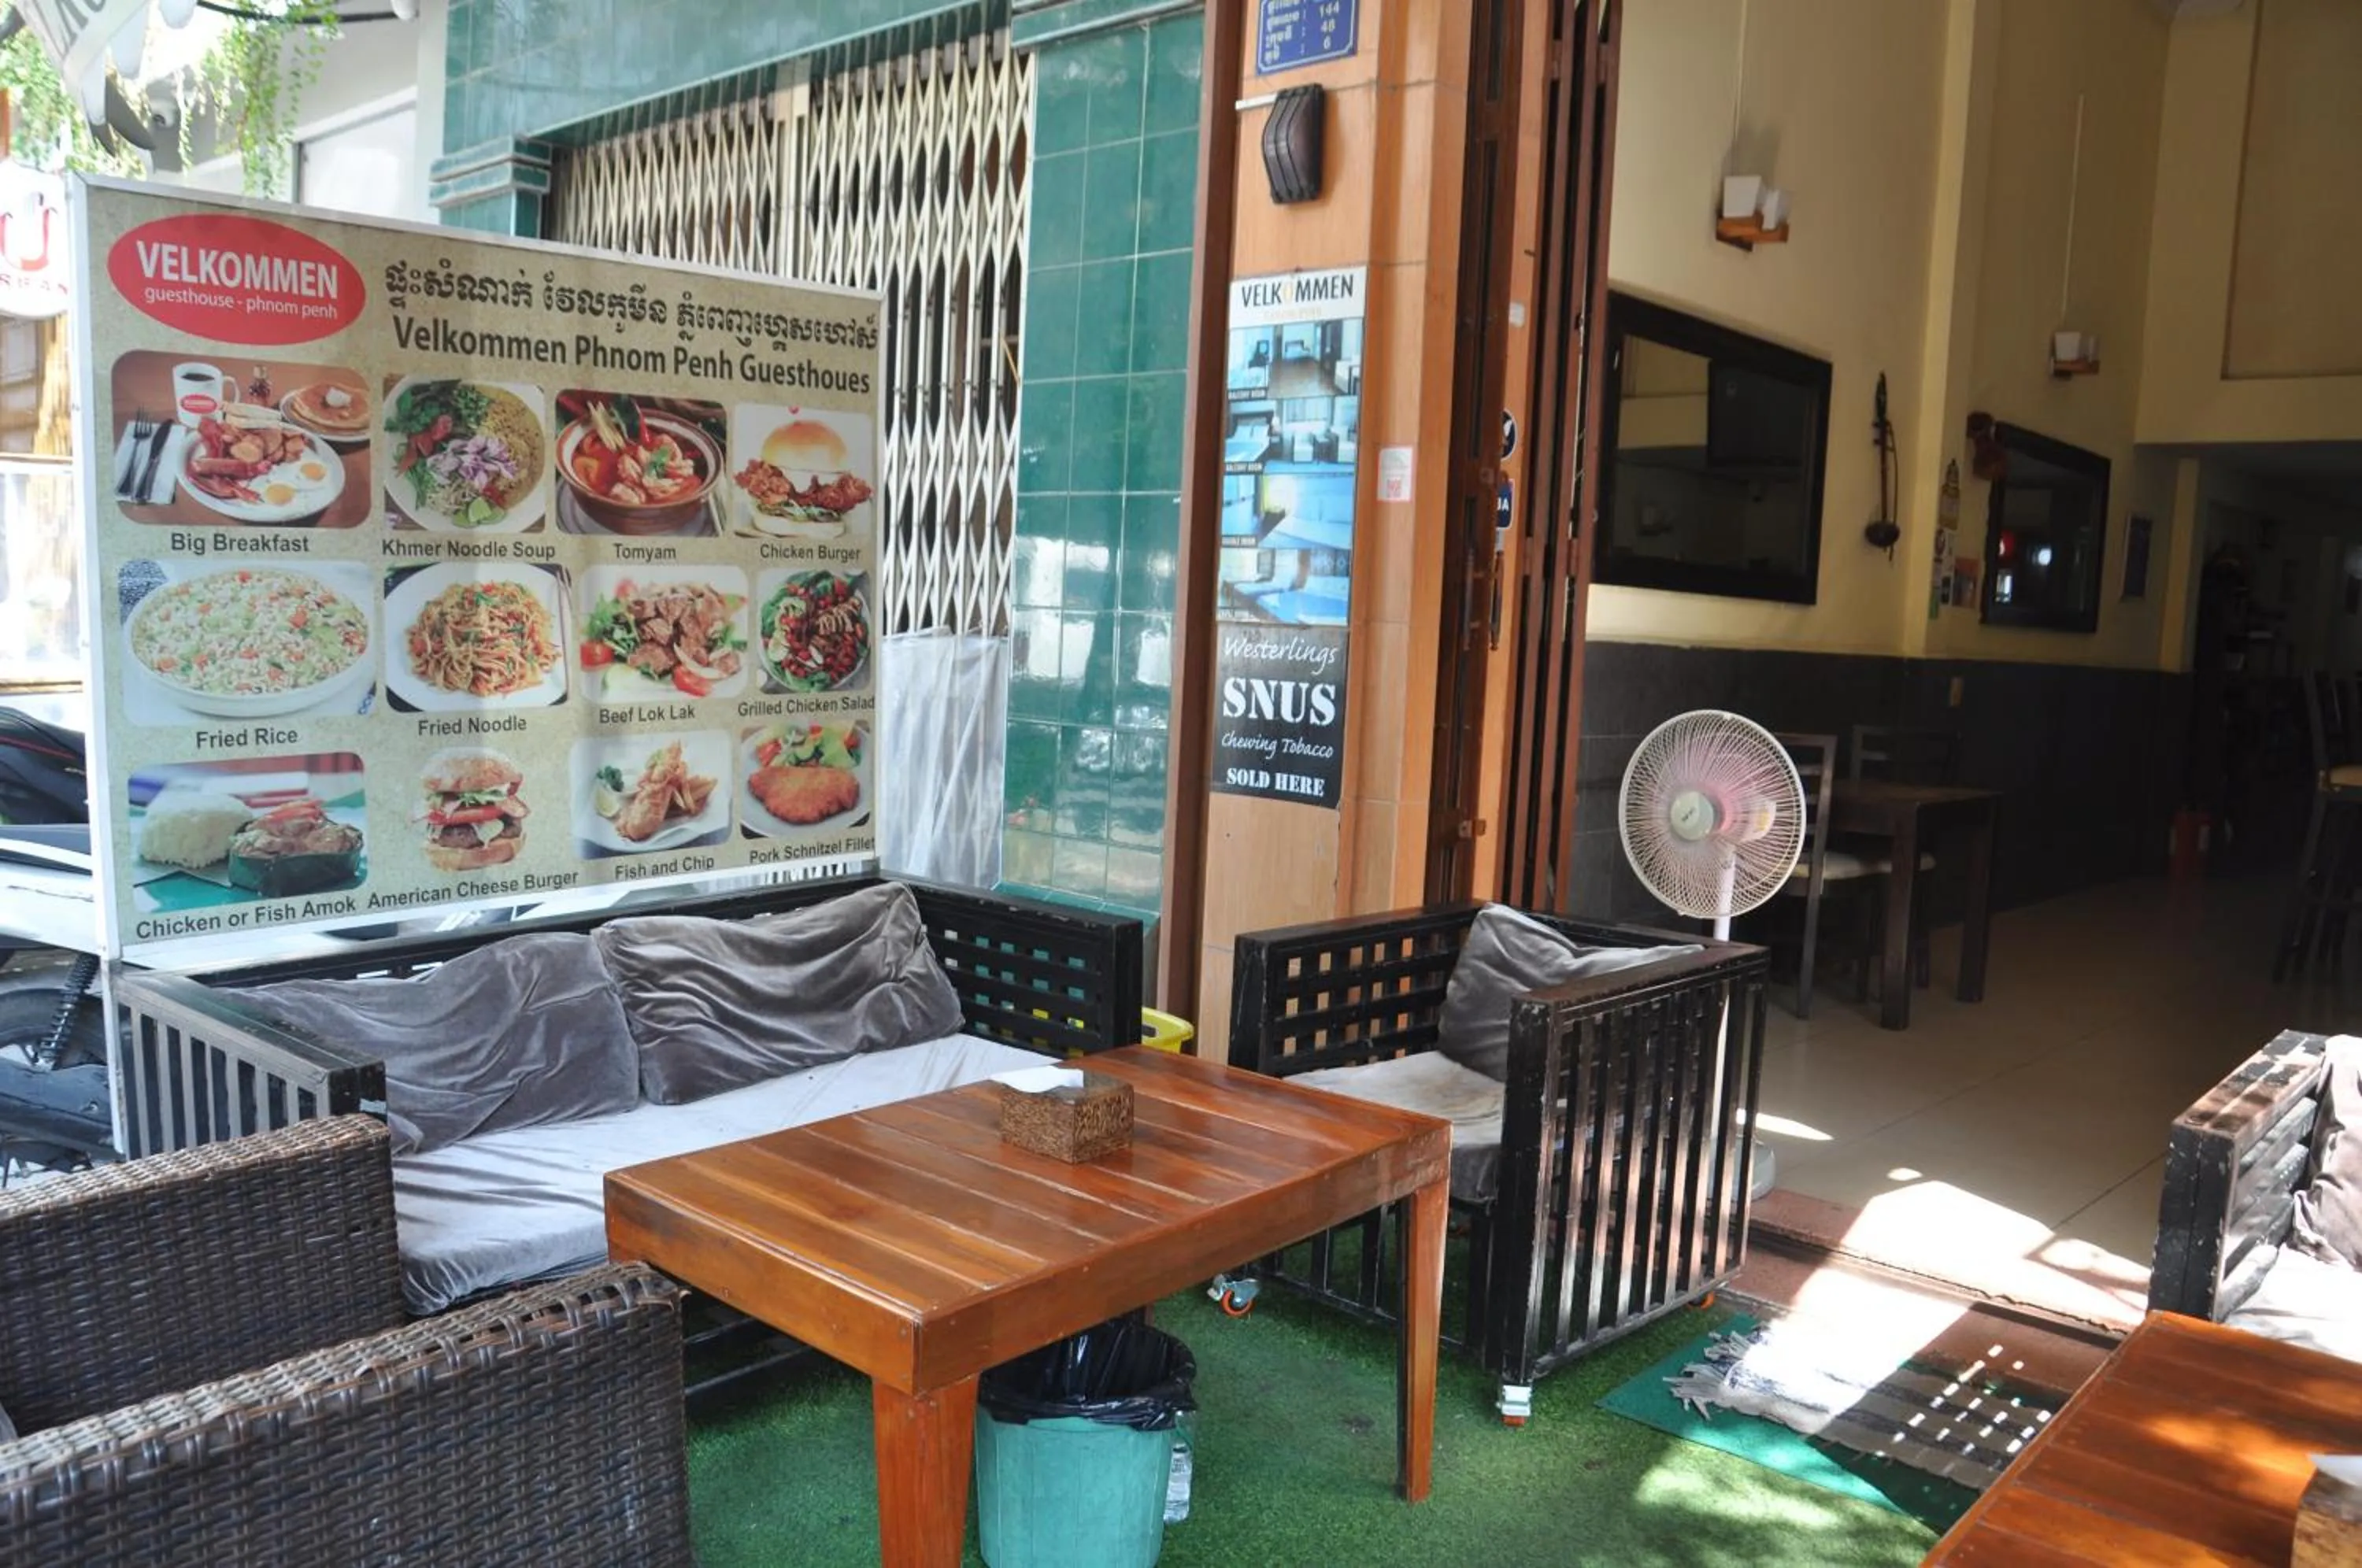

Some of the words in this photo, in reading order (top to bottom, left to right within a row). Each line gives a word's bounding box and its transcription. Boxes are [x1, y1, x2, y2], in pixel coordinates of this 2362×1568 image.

[136, 240, 338, 299] VELKOMMEN
[145, 287, 234, 308] guesthouse
[246, 296, 298, 314] phnom
[302, 304, 338, 319] penh
[393, 315, 566, 364] Velkommen
[576, 335, 665, 374] Phnom
[674, 346, 733, 380] Penh
[740, 354, 870, 394] Guesthoues
[172, 534, 205, 554] Big
[213, 534, 309, 552] Breakfast
[383, 538, 442, 557] Khmer
[448, 541, 507, 557] Noodle
[513, 542, 556, 560] Soup
[613, 543, 676, 562] Tomyam
[760, 544, 813, 559] Chicken
[818, 545, 861, 563] Burger
[1223, 636, 1338, 675] Westerlings
[599, 708, 634, 724] Beef
[639, 706, 665, 721] Lok
[671, 705, 695, 719] Lak
[738, 701, 783, 716] Grilled
[787, 698, 836, 713] Chicken
[841, 696, 876, 710] Salad
[1222, 676, 1336, 726] SNUS
[196, 729, 248, 749] Fried
[255, 728, 298, 745] Rice
[418, 719, 461, 736] Fried
[468, 716, 527, 734] Noodle
[1221, 730, 1277, 760] Chewing
[1282, 738, 1335, 758] Tobacco
[1226, 767, 1270, 788] SOLD
[1275, 772, 1325, 797] HERE
[750, 846, 780, 863] Pork
[784, 841, 842, 860] Schnitzel
[846, 836, 876, 853] Fillet
[616, 864, 647, 880] Fish
[651, 861, 678, 876] and
[683, 856, 714, 874] Chip
[368, 887, 451, 909] American
[457, 877, 519, 897] Cheese
[524, 871, 579, 891] Burger
[136, 913, 221, 938] Chicken
[228, 912, 247, 926] or
[255, 903, 296, 923] Fish
[302, 899, 356, 917] Amok
